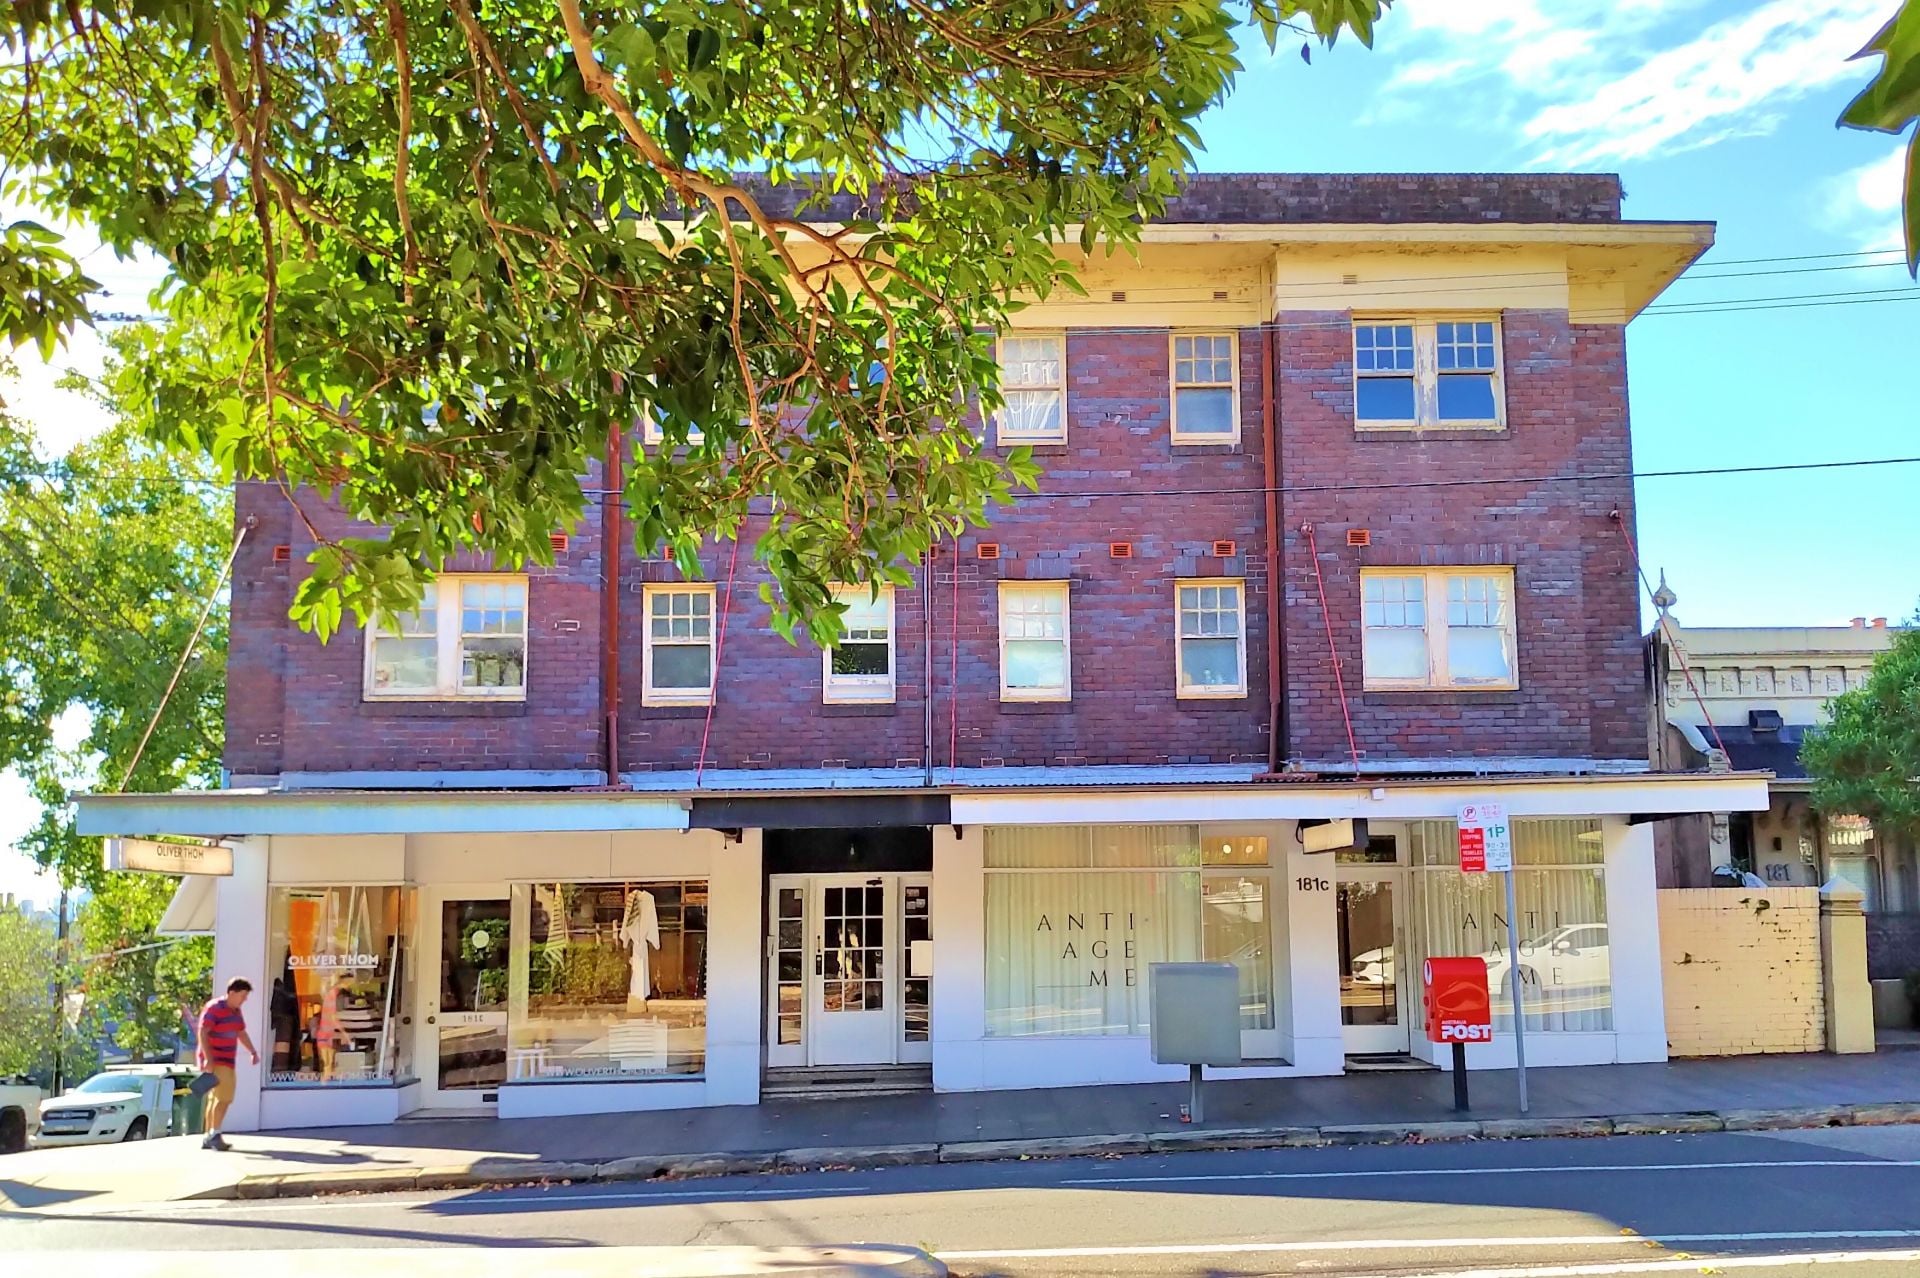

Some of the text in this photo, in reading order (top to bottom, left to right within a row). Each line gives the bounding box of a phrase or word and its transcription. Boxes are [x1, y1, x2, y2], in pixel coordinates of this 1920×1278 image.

[1487, 826, 1505, 838] 1P
[157, 845, 204, 859] OLIVER THOM
[1766, 863, 1791, 881] 181
[1296, 877, 1329, 891] 181c
[1037, 912, 1134, 931] ANTI
[1463, 911, 1559, 929] ANTI
[1062, 940, 1136, 959] AGE
[1489, 939, 1562, 957] AGE
[288, 954, 379, 966] OLIVER THOM
[1089, 968, 1136, 987] ME
[1517, 967, 1563, 985] ME
[1442, 1024, 1491, 1039] POST
